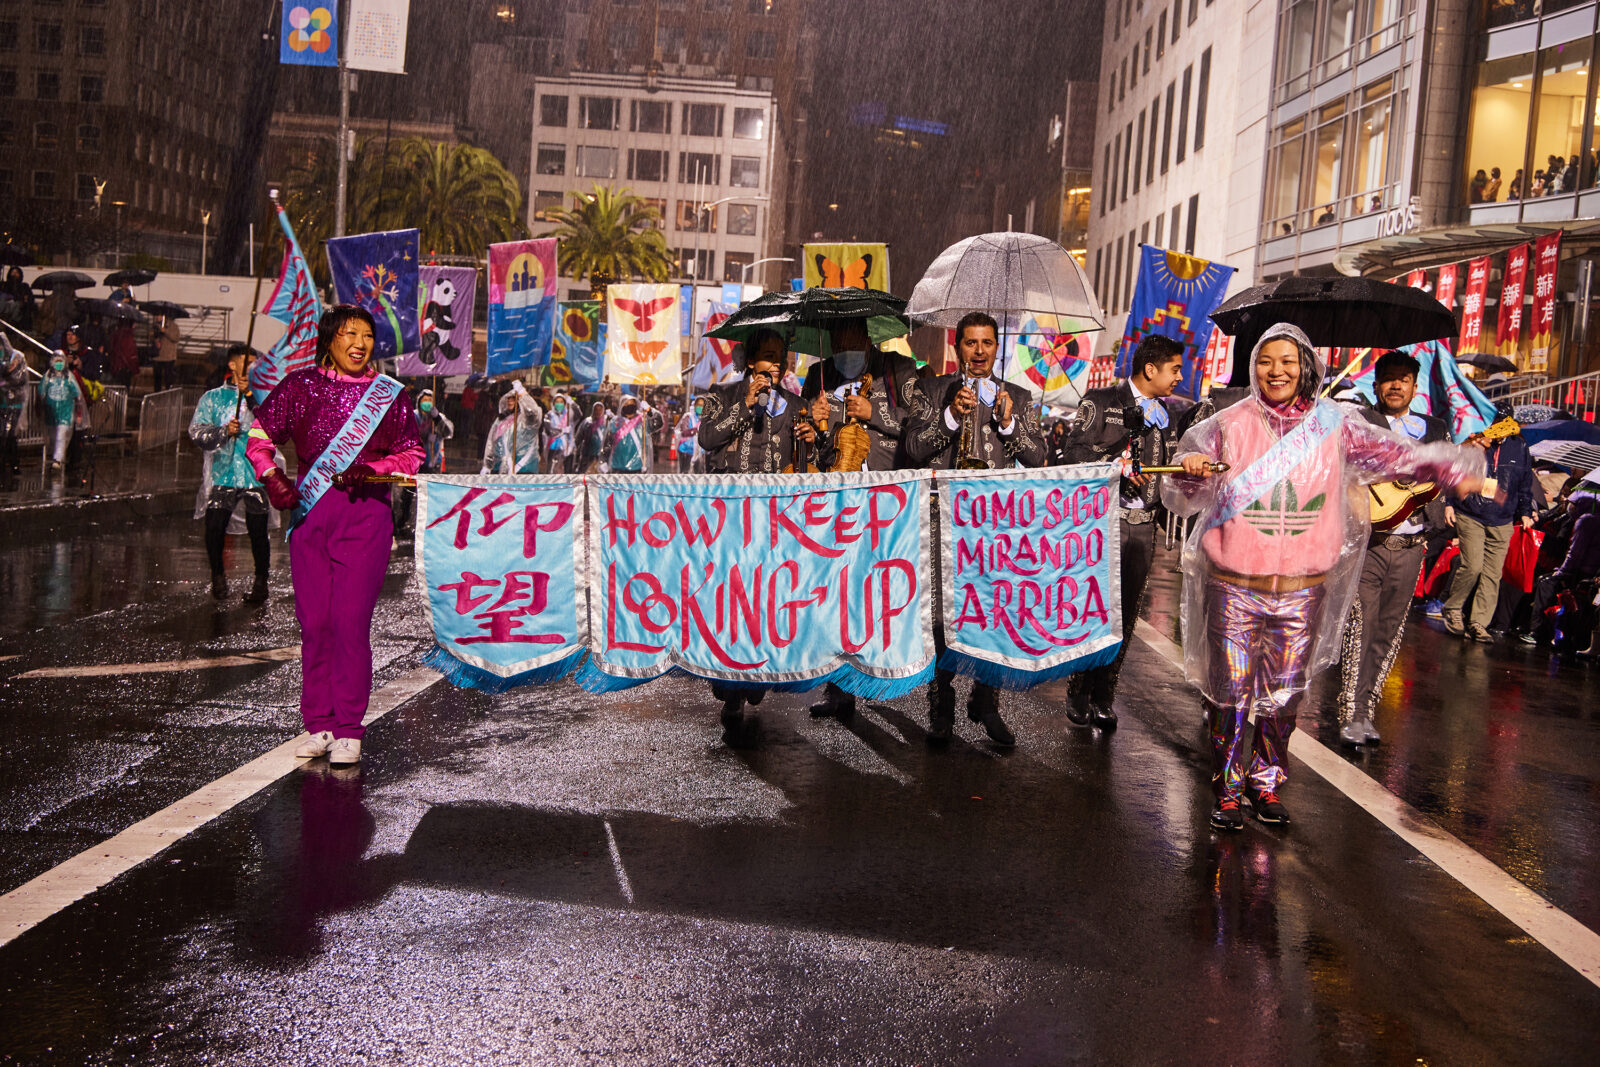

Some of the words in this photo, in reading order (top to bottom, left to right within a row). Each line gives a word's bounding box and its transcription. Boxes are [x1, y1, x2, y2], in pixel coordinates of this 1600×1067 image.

[317, 456, 338, 482] SIGO
[330, 417, 372, 463] MIRANDO
[368, 378, 396, 419] ARRIBA
[605, 492, 726, 549] HOW
[742, 496, 752, 549] I
[769, 484, 907, 559] KEEP
[954, 489, 1035, 530] COMO
[1042, 485, 1110, 530] SIGO
[426, 488, 574, 645] 仰望
[957, 529, 1104, 577] MIRANDO
[605, 561, 828, 670] LOOKING
[840, 558, 917, 654] UP
[950, 578, 1110, 656] ARRIBA
